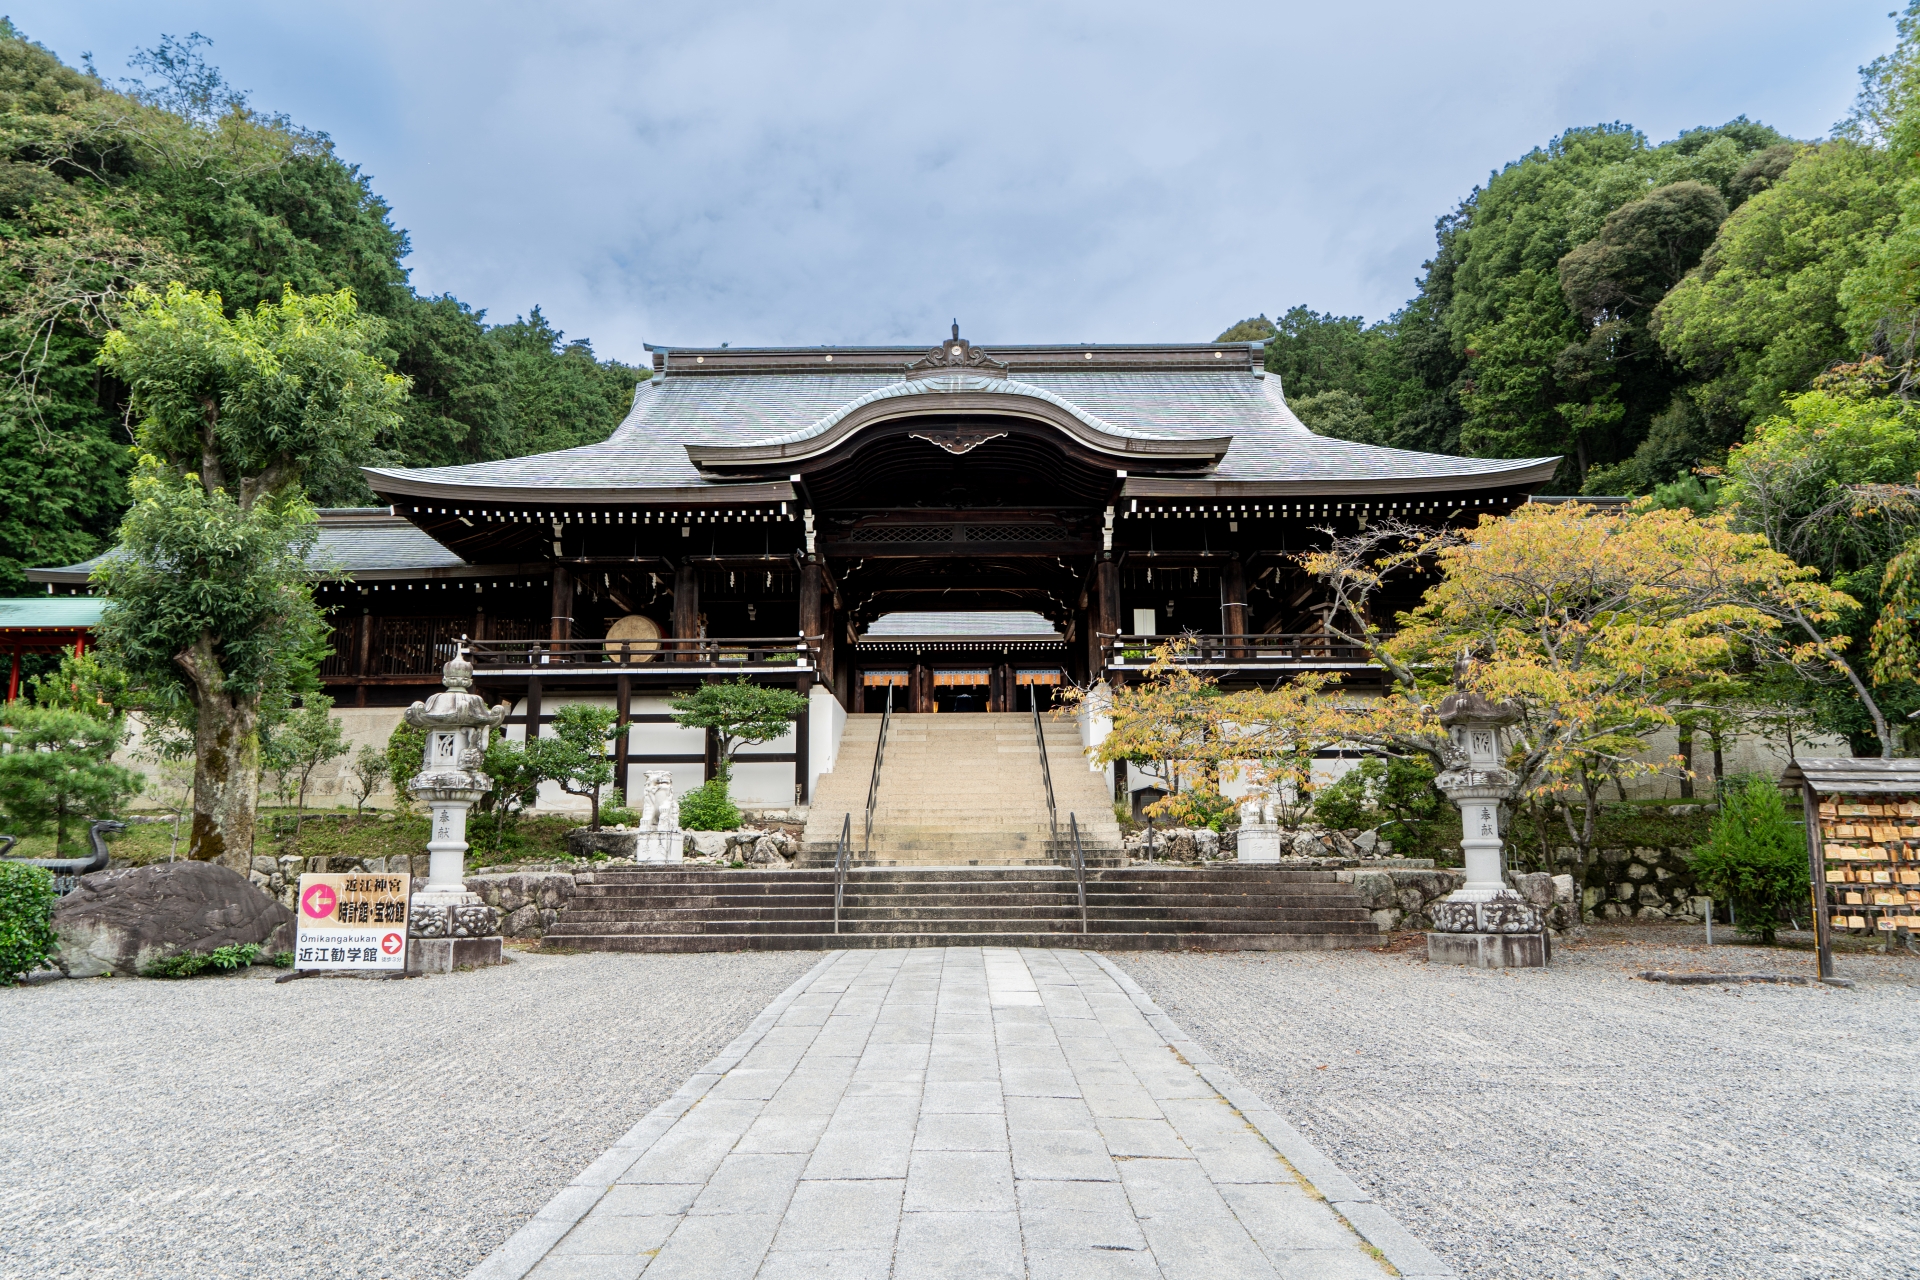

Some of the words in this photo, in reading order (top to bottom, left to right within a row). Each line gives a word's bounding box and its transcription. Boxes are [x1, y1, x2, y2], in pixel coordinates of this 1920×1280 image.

[345, 878, 402, 892] 近江神宮
[338, 901, 405, 924] 時計館・宝物館
[298, 947, 378, 962] 近江勧学館
